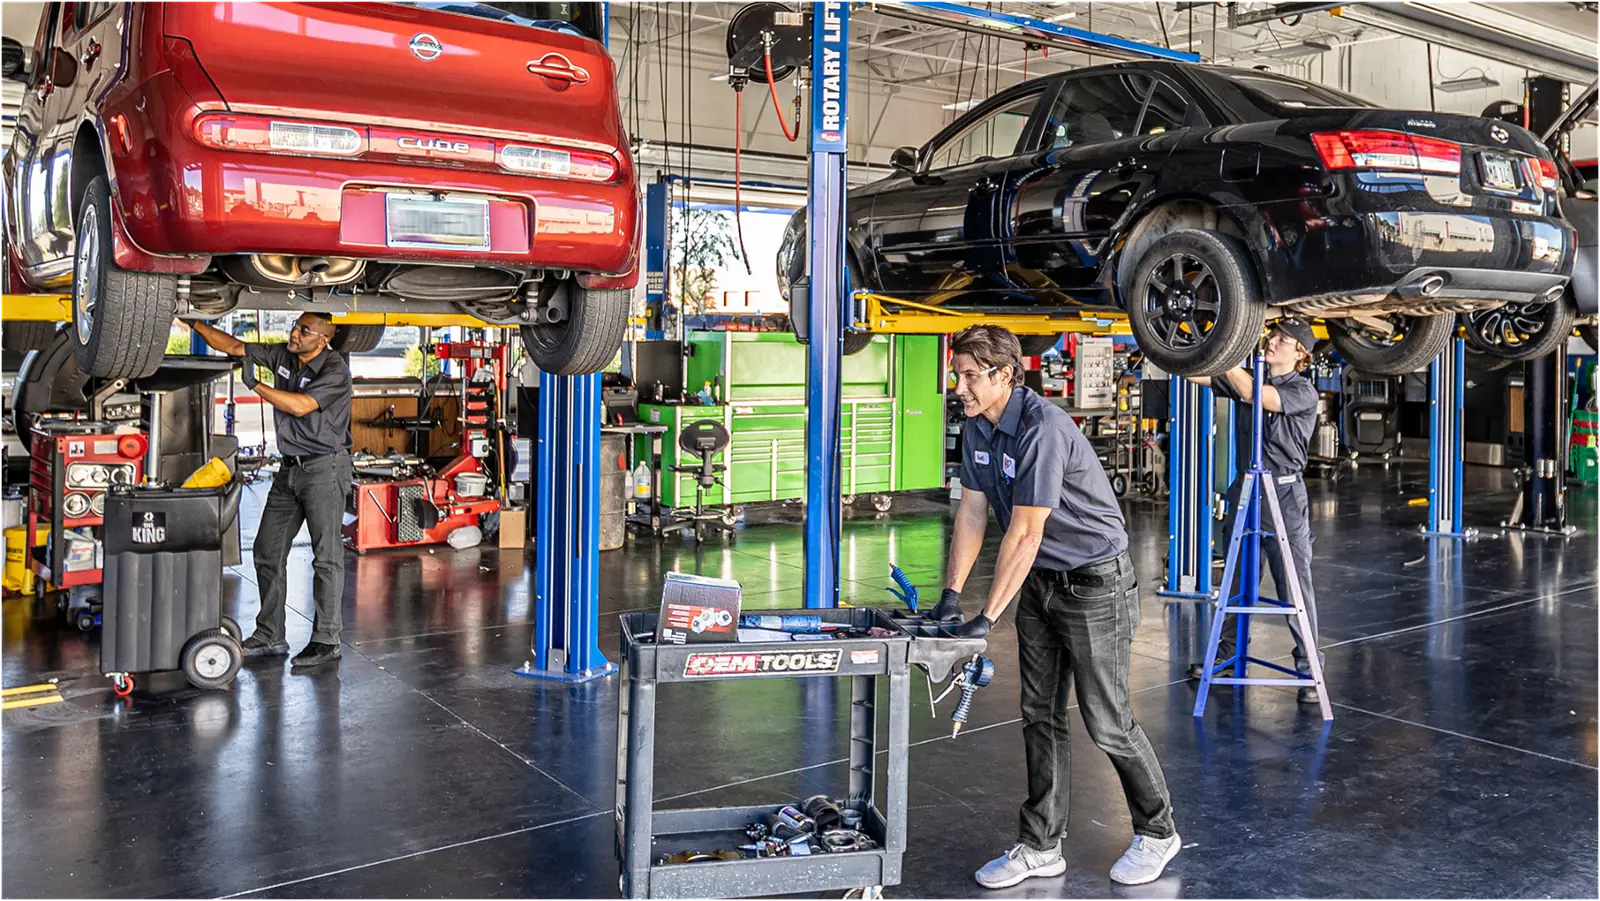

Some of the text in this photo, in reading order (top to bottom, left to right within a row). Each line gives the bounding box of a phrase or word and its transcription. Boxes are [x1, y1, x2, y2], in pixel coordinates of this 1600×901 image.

[823, 47, 841, 131] ROTARY
[397, 137, 470, 153] cube
[133, 526, 166, 543] KING
